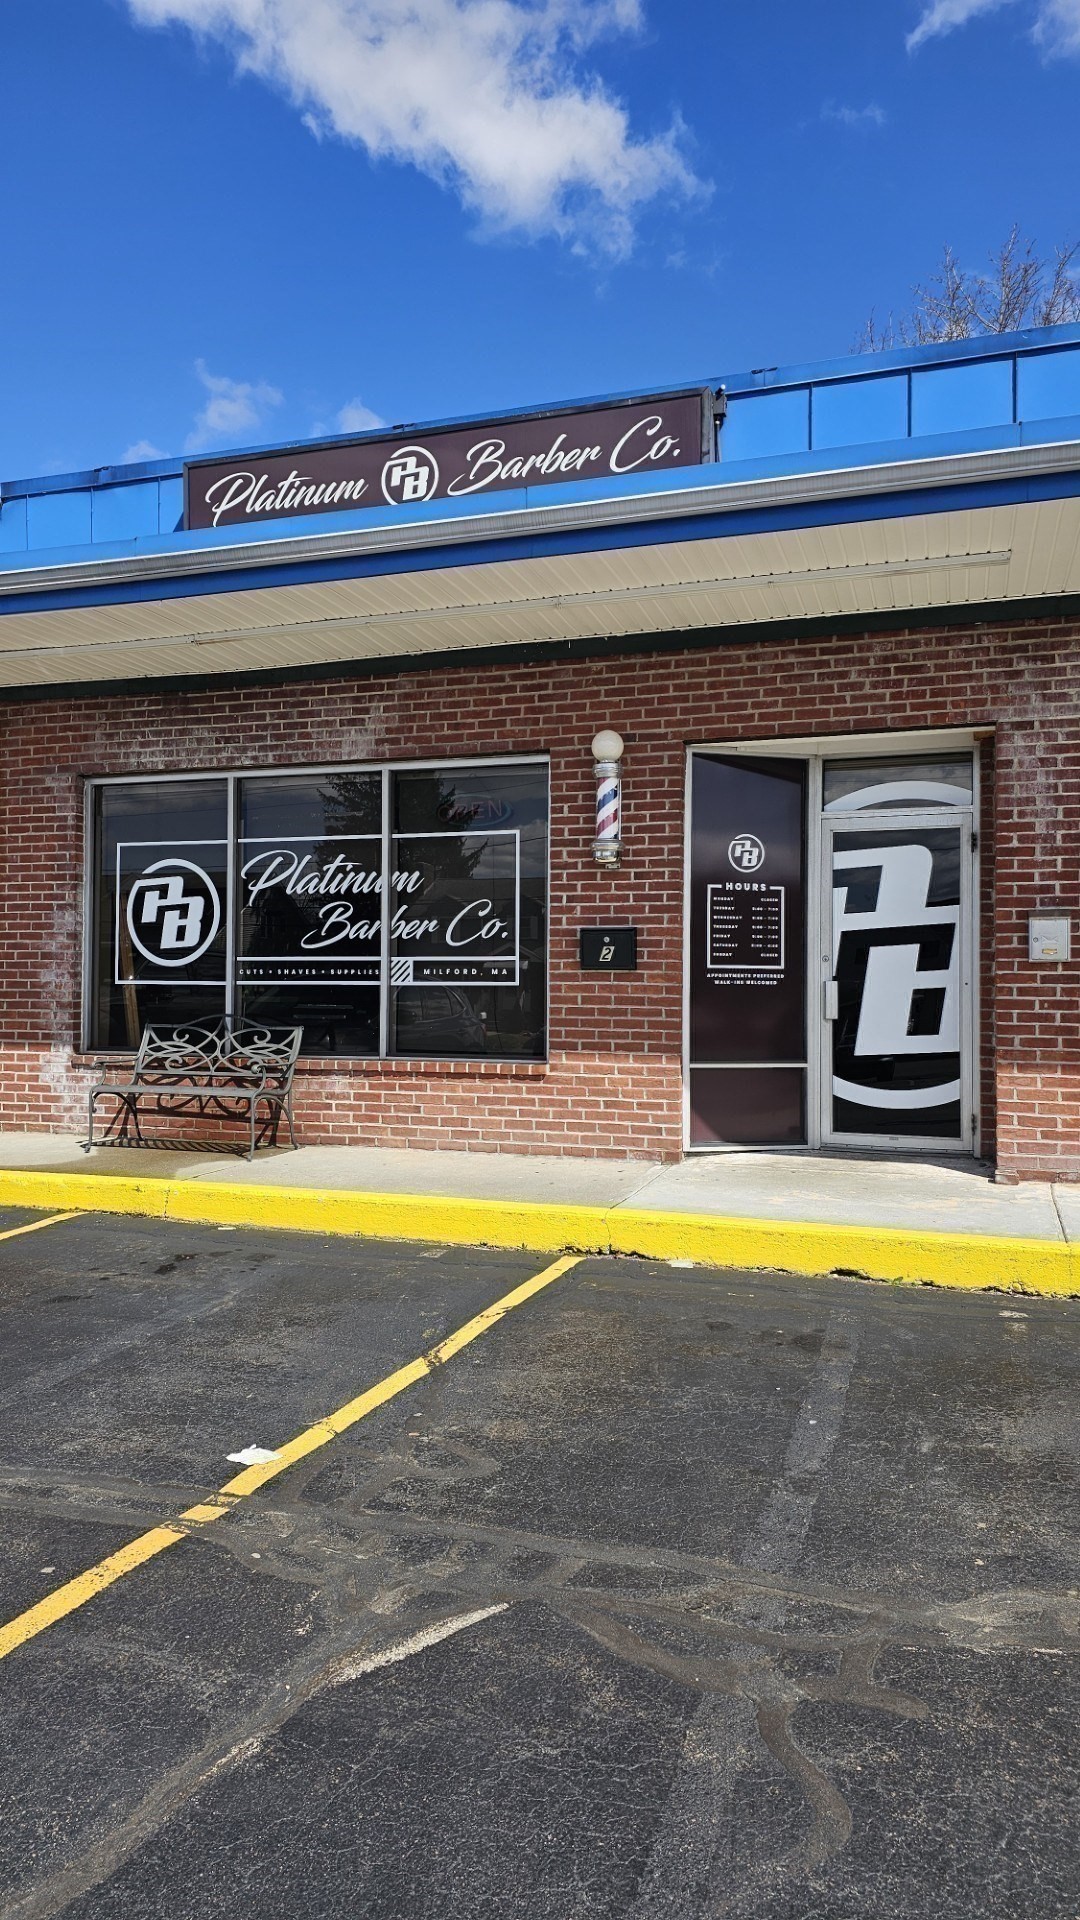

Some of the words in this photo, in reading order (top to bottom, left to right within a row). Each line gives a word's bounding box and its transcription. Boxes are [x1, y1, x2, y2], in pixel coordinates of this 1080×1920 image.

[205, 470, 369, 527] Platinum
[447, 433, 602, 496] Barber
[609, 415, 681, 473] Co.
[437, 799, 503, 823] OPEN
[240, 850, 425, 907] Platinum
[725, 882, 767, 892] HOURS
[300, 900, 441, 949] Barber
[445, 898, 509, 947] Co.
